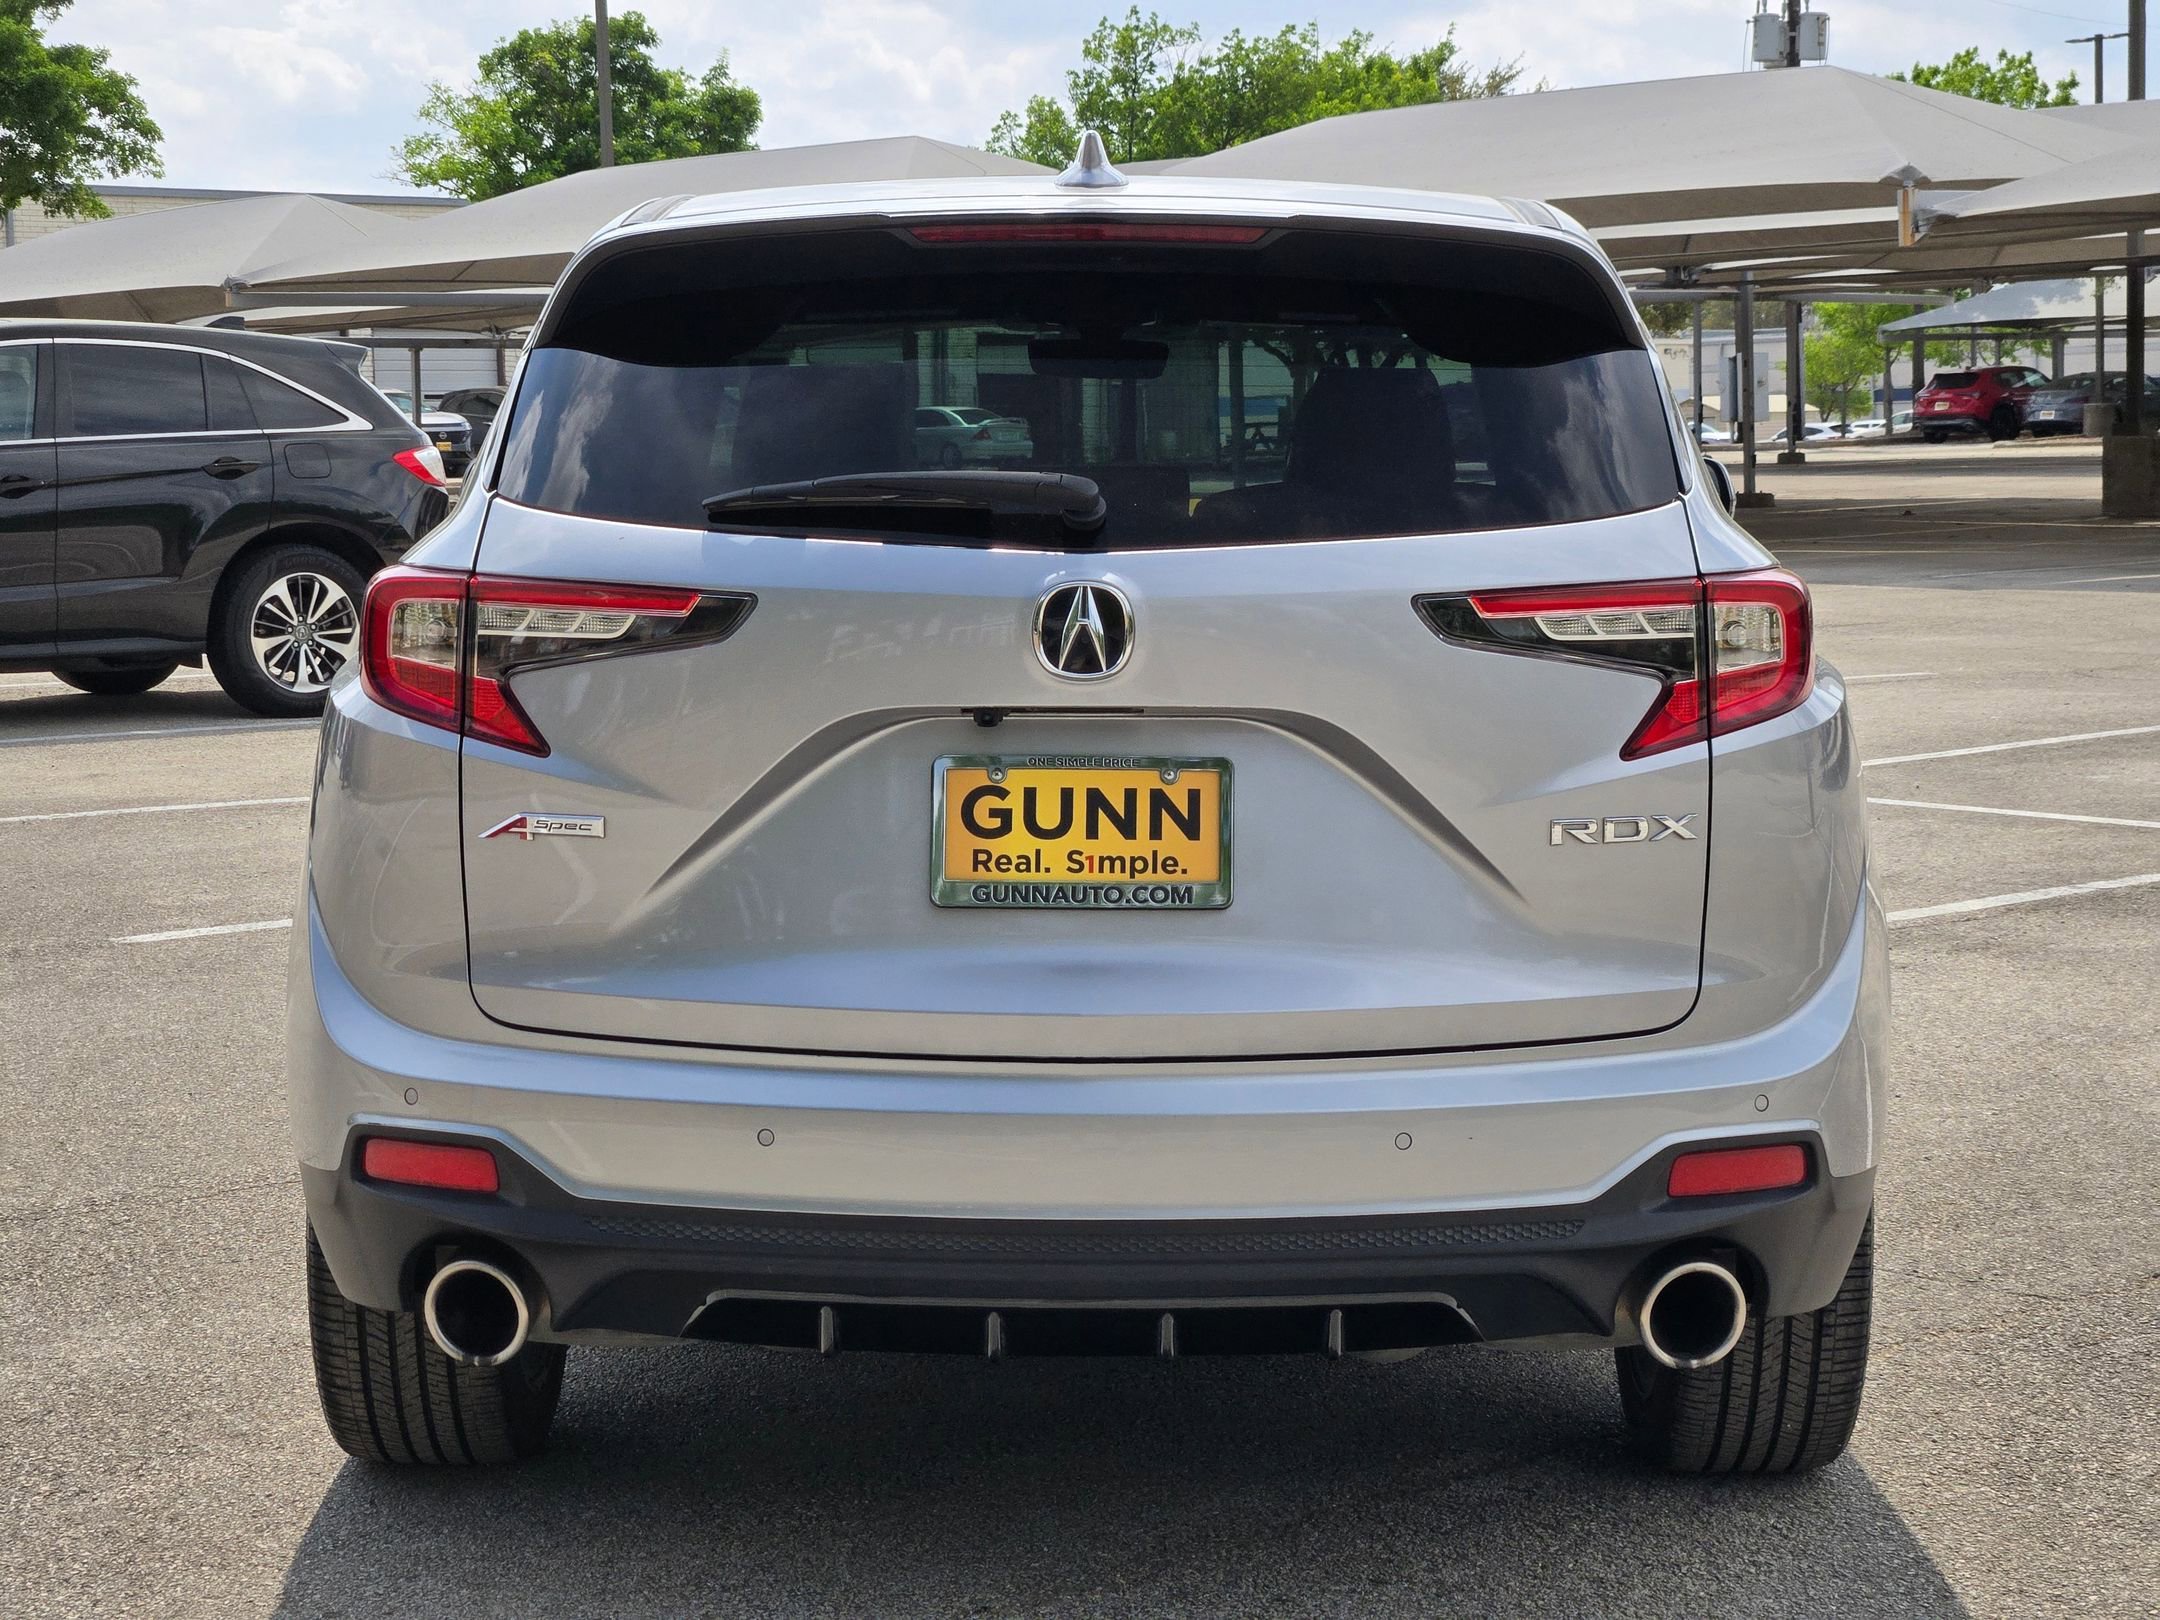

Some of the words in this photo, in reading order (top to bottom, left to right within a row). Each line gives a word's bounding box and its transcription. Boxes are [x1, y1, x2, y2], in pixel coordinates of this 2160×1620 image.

[1026, 756, 1052, 768] ONE
[1055, 756, 1100, 768] SIMPLE
[1102, 756, 1141, 769] PRICE
[961, 784, 1201, 841] GUNN
[1550, 813, 1698, 846] RDX
[972, 848, 1050, 874] Real.
[971, 884, 1194, 905] GUNNAUTO.COM
